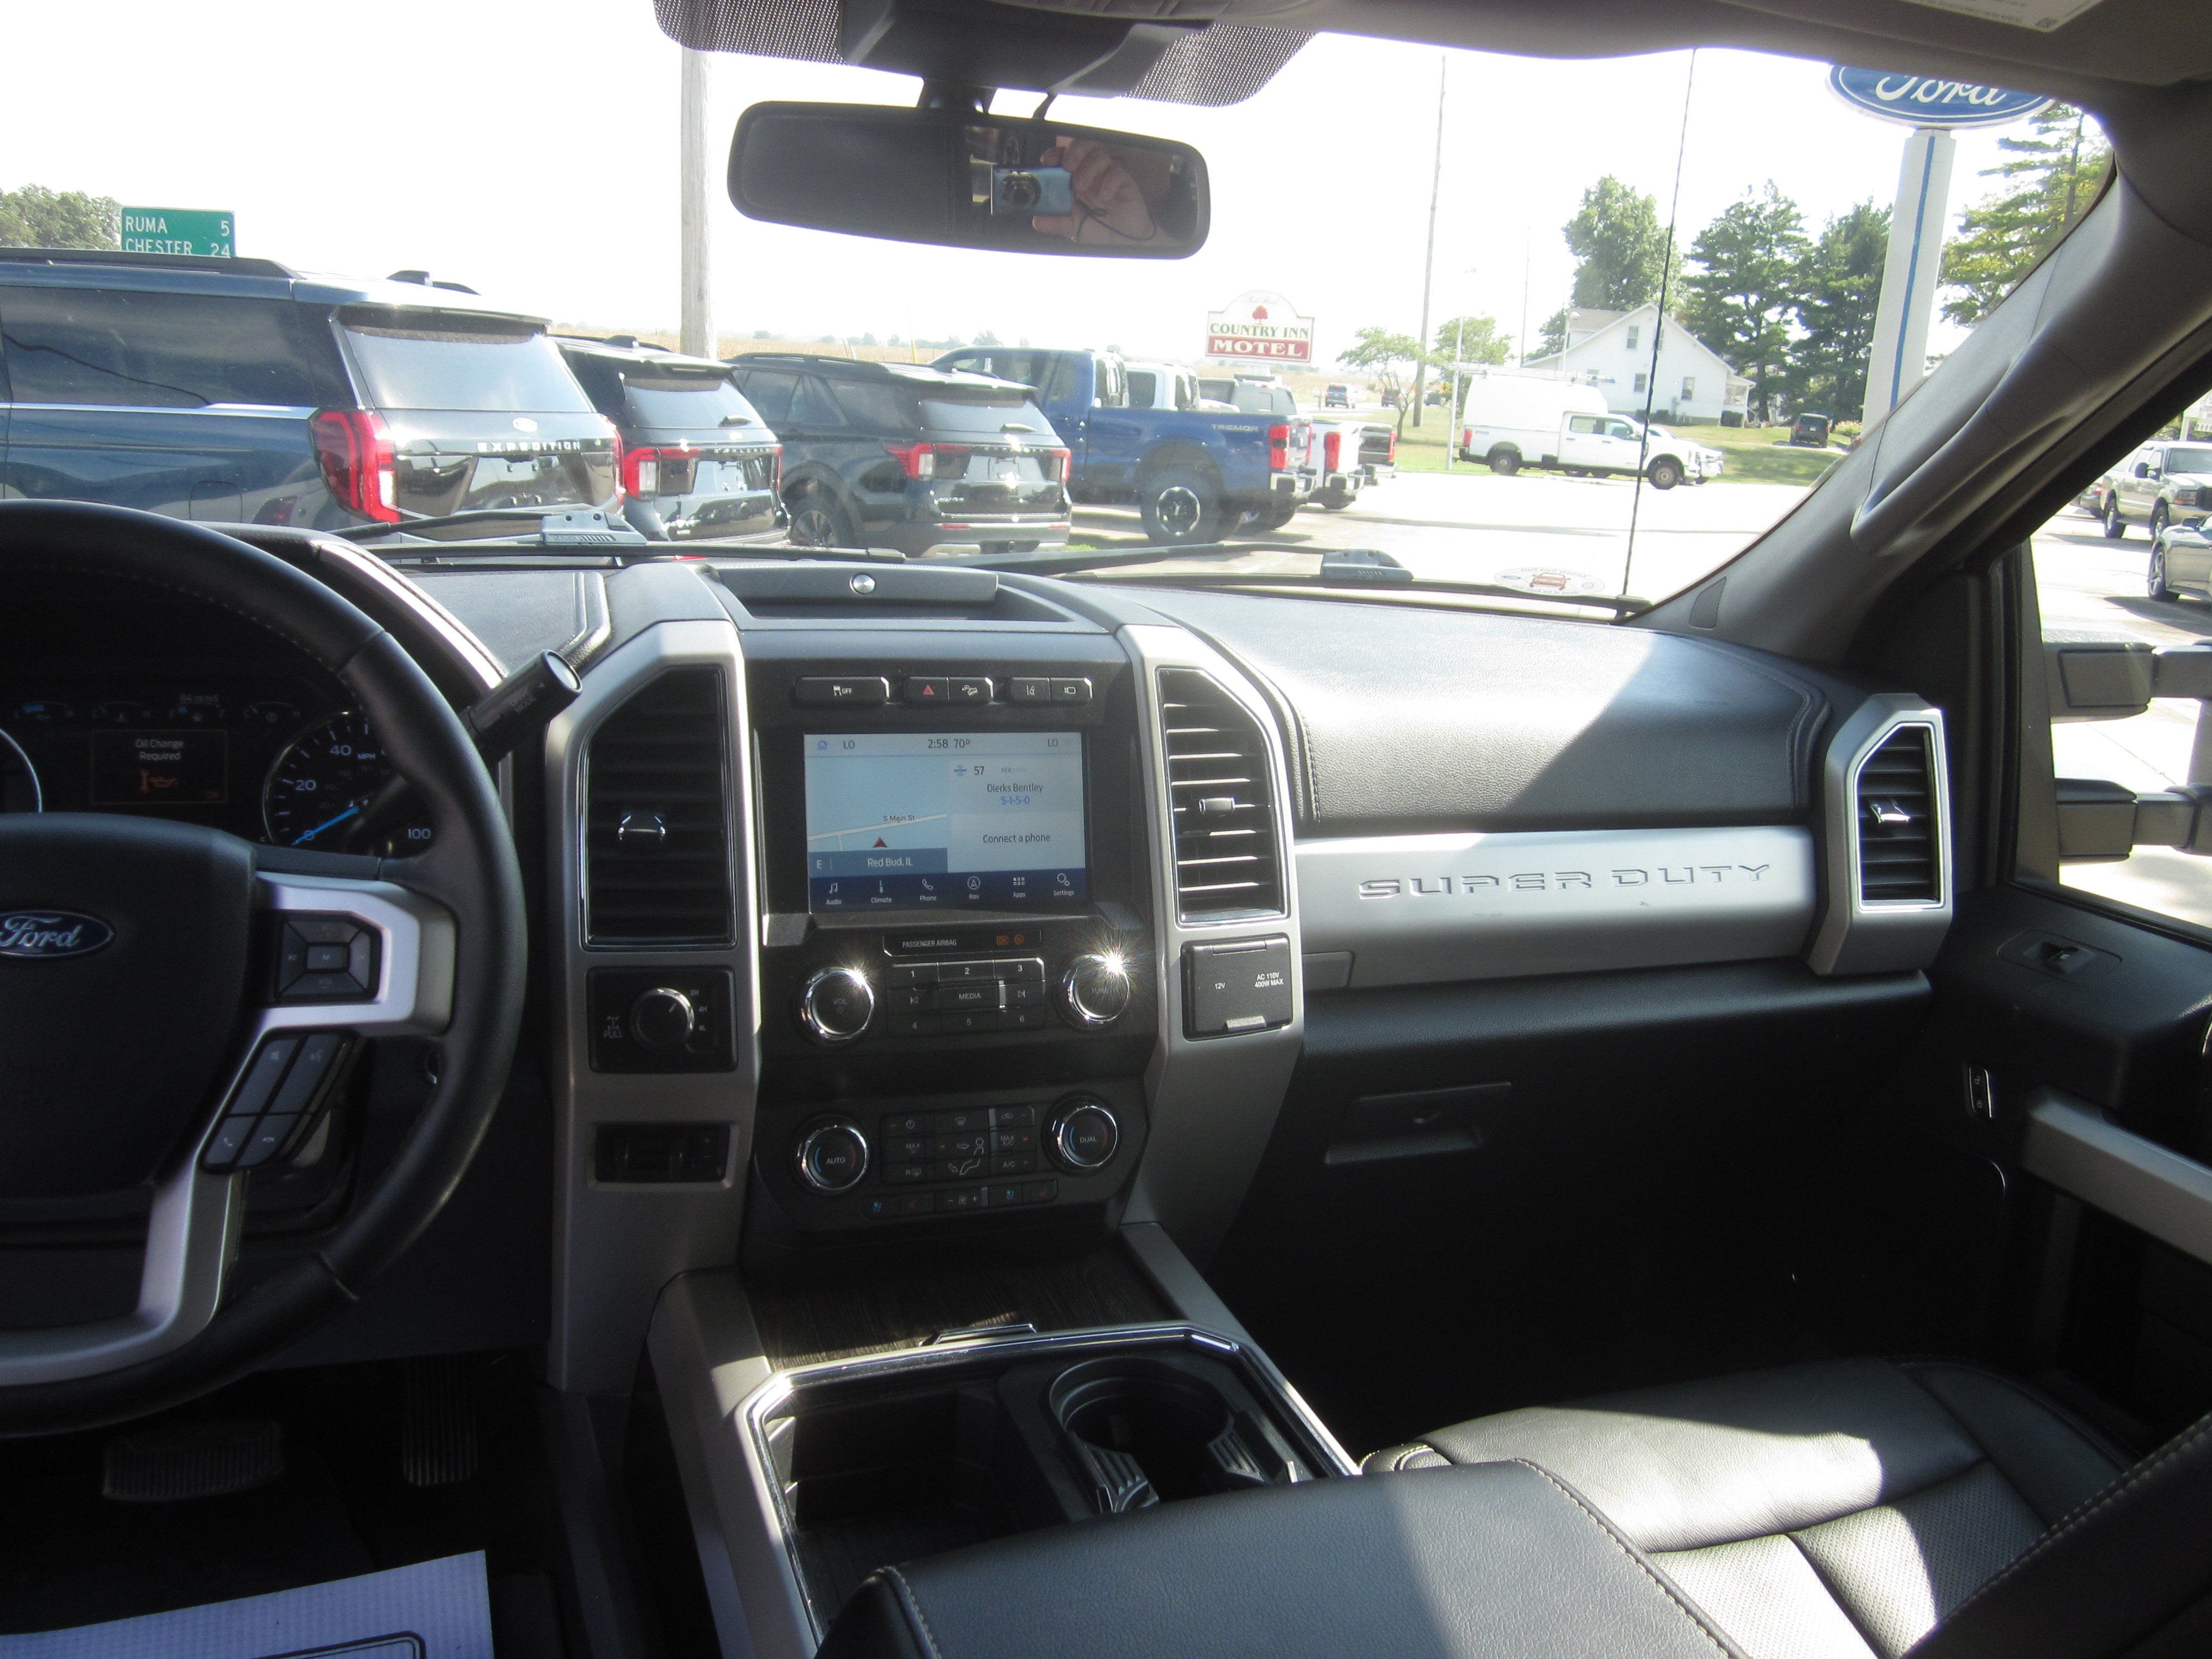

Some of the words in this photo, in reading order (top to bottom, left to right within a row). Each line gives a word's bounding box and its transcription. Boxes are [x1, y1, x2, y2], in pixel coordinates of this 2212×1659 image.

[126, 216, 168, 234] RUMA
[221, 220, 230, 237] 5
[126, 238, 192, 255] CHESTER
[210, 243, 230, 258] 24
[1209, 322, 1279, 337] COUNTRY
[1283, 327, 1309, 338] INN
[1213, 339, 1303, 356] MOTEL
[1212, 424, 1259, 432] TREMOR
[477, 442, 581, 452] EXPEDITION
[150, 739, 184, 749] Change
[843, 740, 855, 749] LO
[927, 739, 948, 748] 2:58
[1047, 738, 1058, 747] LO
[329, 744, 352, 757] 40
[139, 752, 181, 761] Required
[974, 765, 985, 775] 57
[295, 779, 317, 791] 20
[987, 783, 1011, 792] Dierks
[1013, 782, 1043, 793] Bentley
[1001, 796, 1030, 805] 5-1-5-0
[406, 828, 431, 839] 100
[983, 834, 1016, 843] Connect
[1025, 833, 1050, 843] phone
[816, 859, 822, 869] E
[868, 858, 883, 867] Red
[906, 857, 913, 867] IL
[1358, 870, 1592, 900] SUPER
[1610, 863, 1770, 888] DUTY
[0, 916, 84, 947] Ford
[902, 940, 936, 948] PASSENGER
[936, 938, 957, 947] AIRBAG
[1017, 964, 1023, 972] 3
[910, 970, 915, 978] 1
[1256, 973, 1266, 982] AC
[1266, 971, 1280, 980] 110V
[1254, 980, 1270, 988] 400W
[1270, 978, 1284, 987] MAX
[603, 1030, 624, 1039] PULL
[1079, 1135, 1098, 1144] DUAL
[826, 1157, 846, 1165] AUTO
